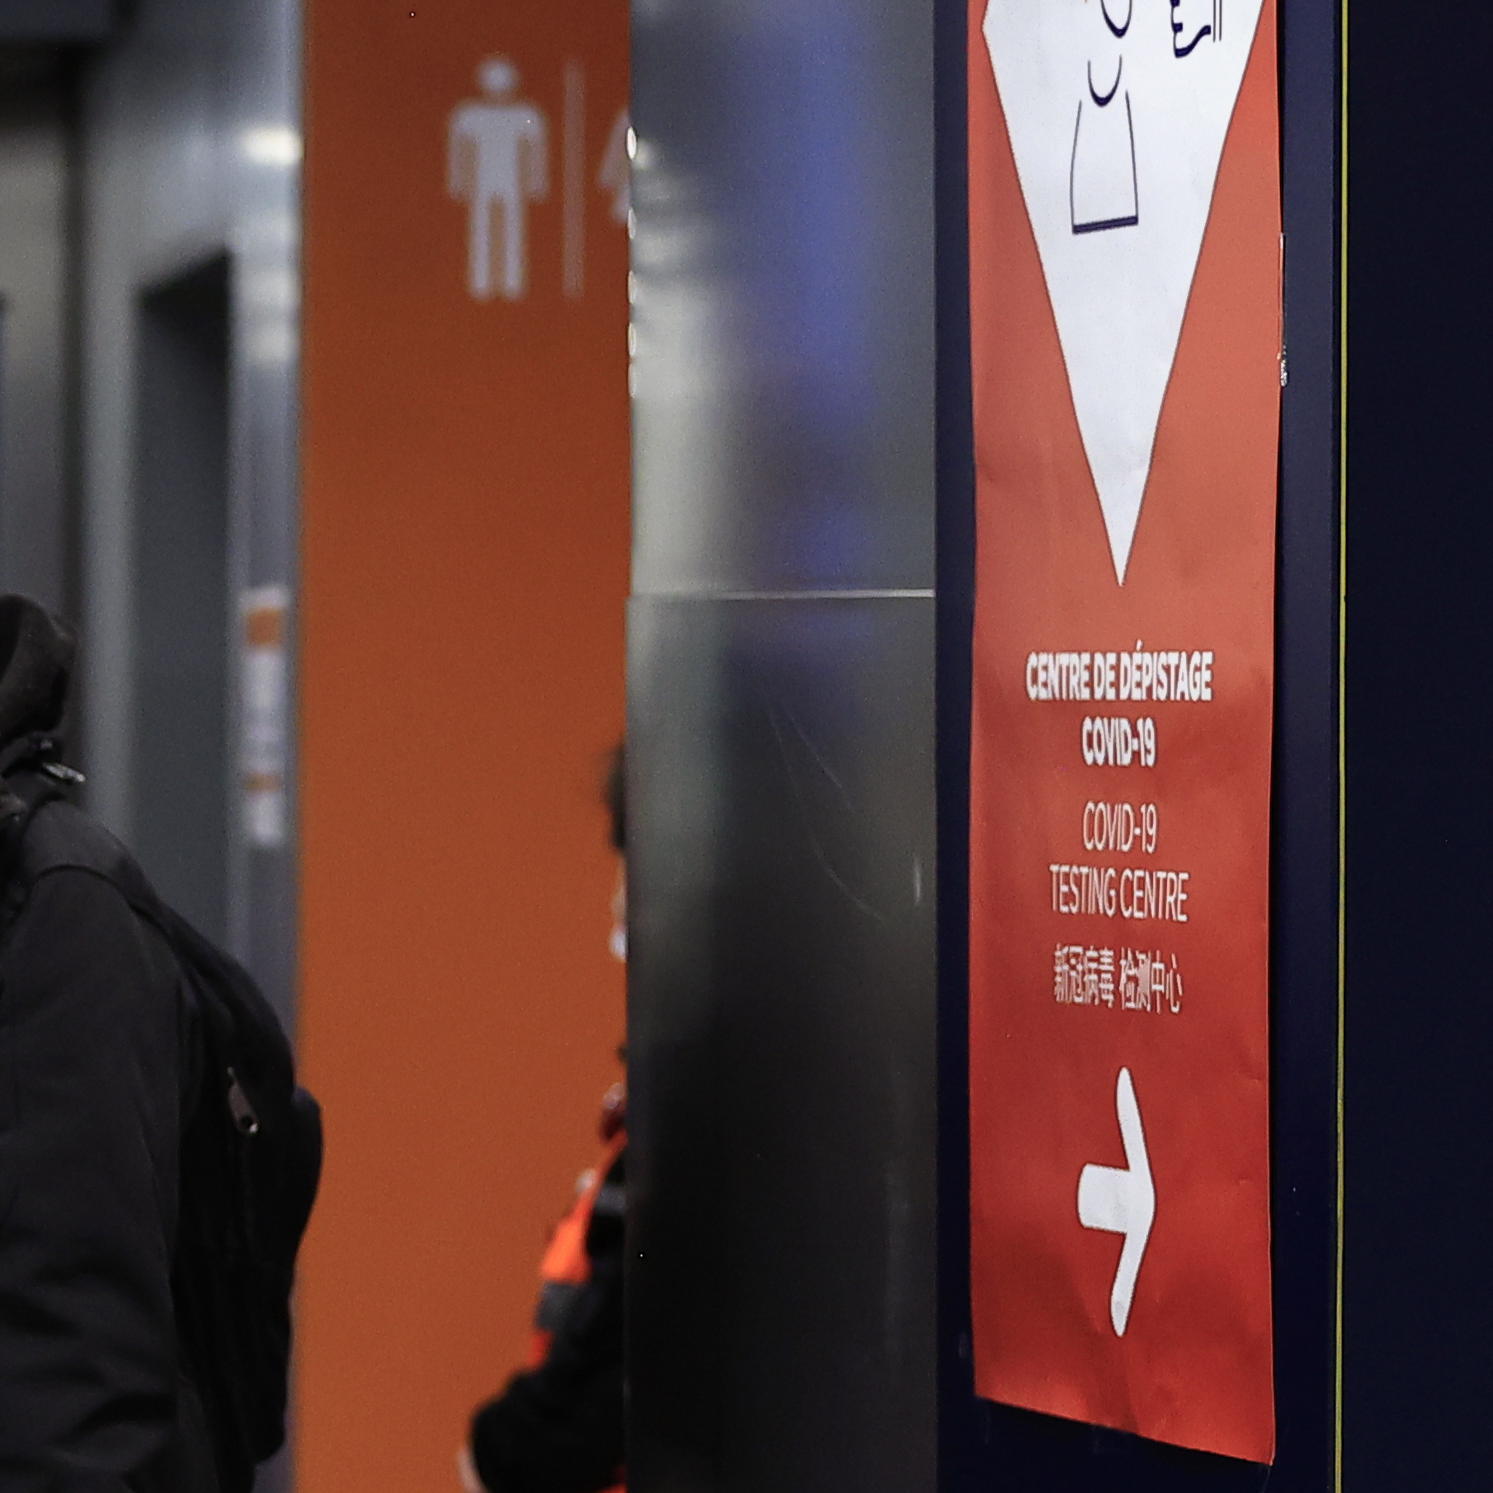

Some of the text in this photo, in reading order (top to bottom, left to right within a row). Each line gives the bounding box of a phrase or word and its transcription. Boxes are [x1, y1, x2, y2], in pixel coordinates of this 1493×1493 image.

[1026, 639, 1213, 702] CENTRE DE DÉPISTAGE
[1082, 716, 1157, 766] COVID-19
[1083, 801, 1158, 854] COVID-19
[1049, 863, 1189, 922] TESTING CENTRE
